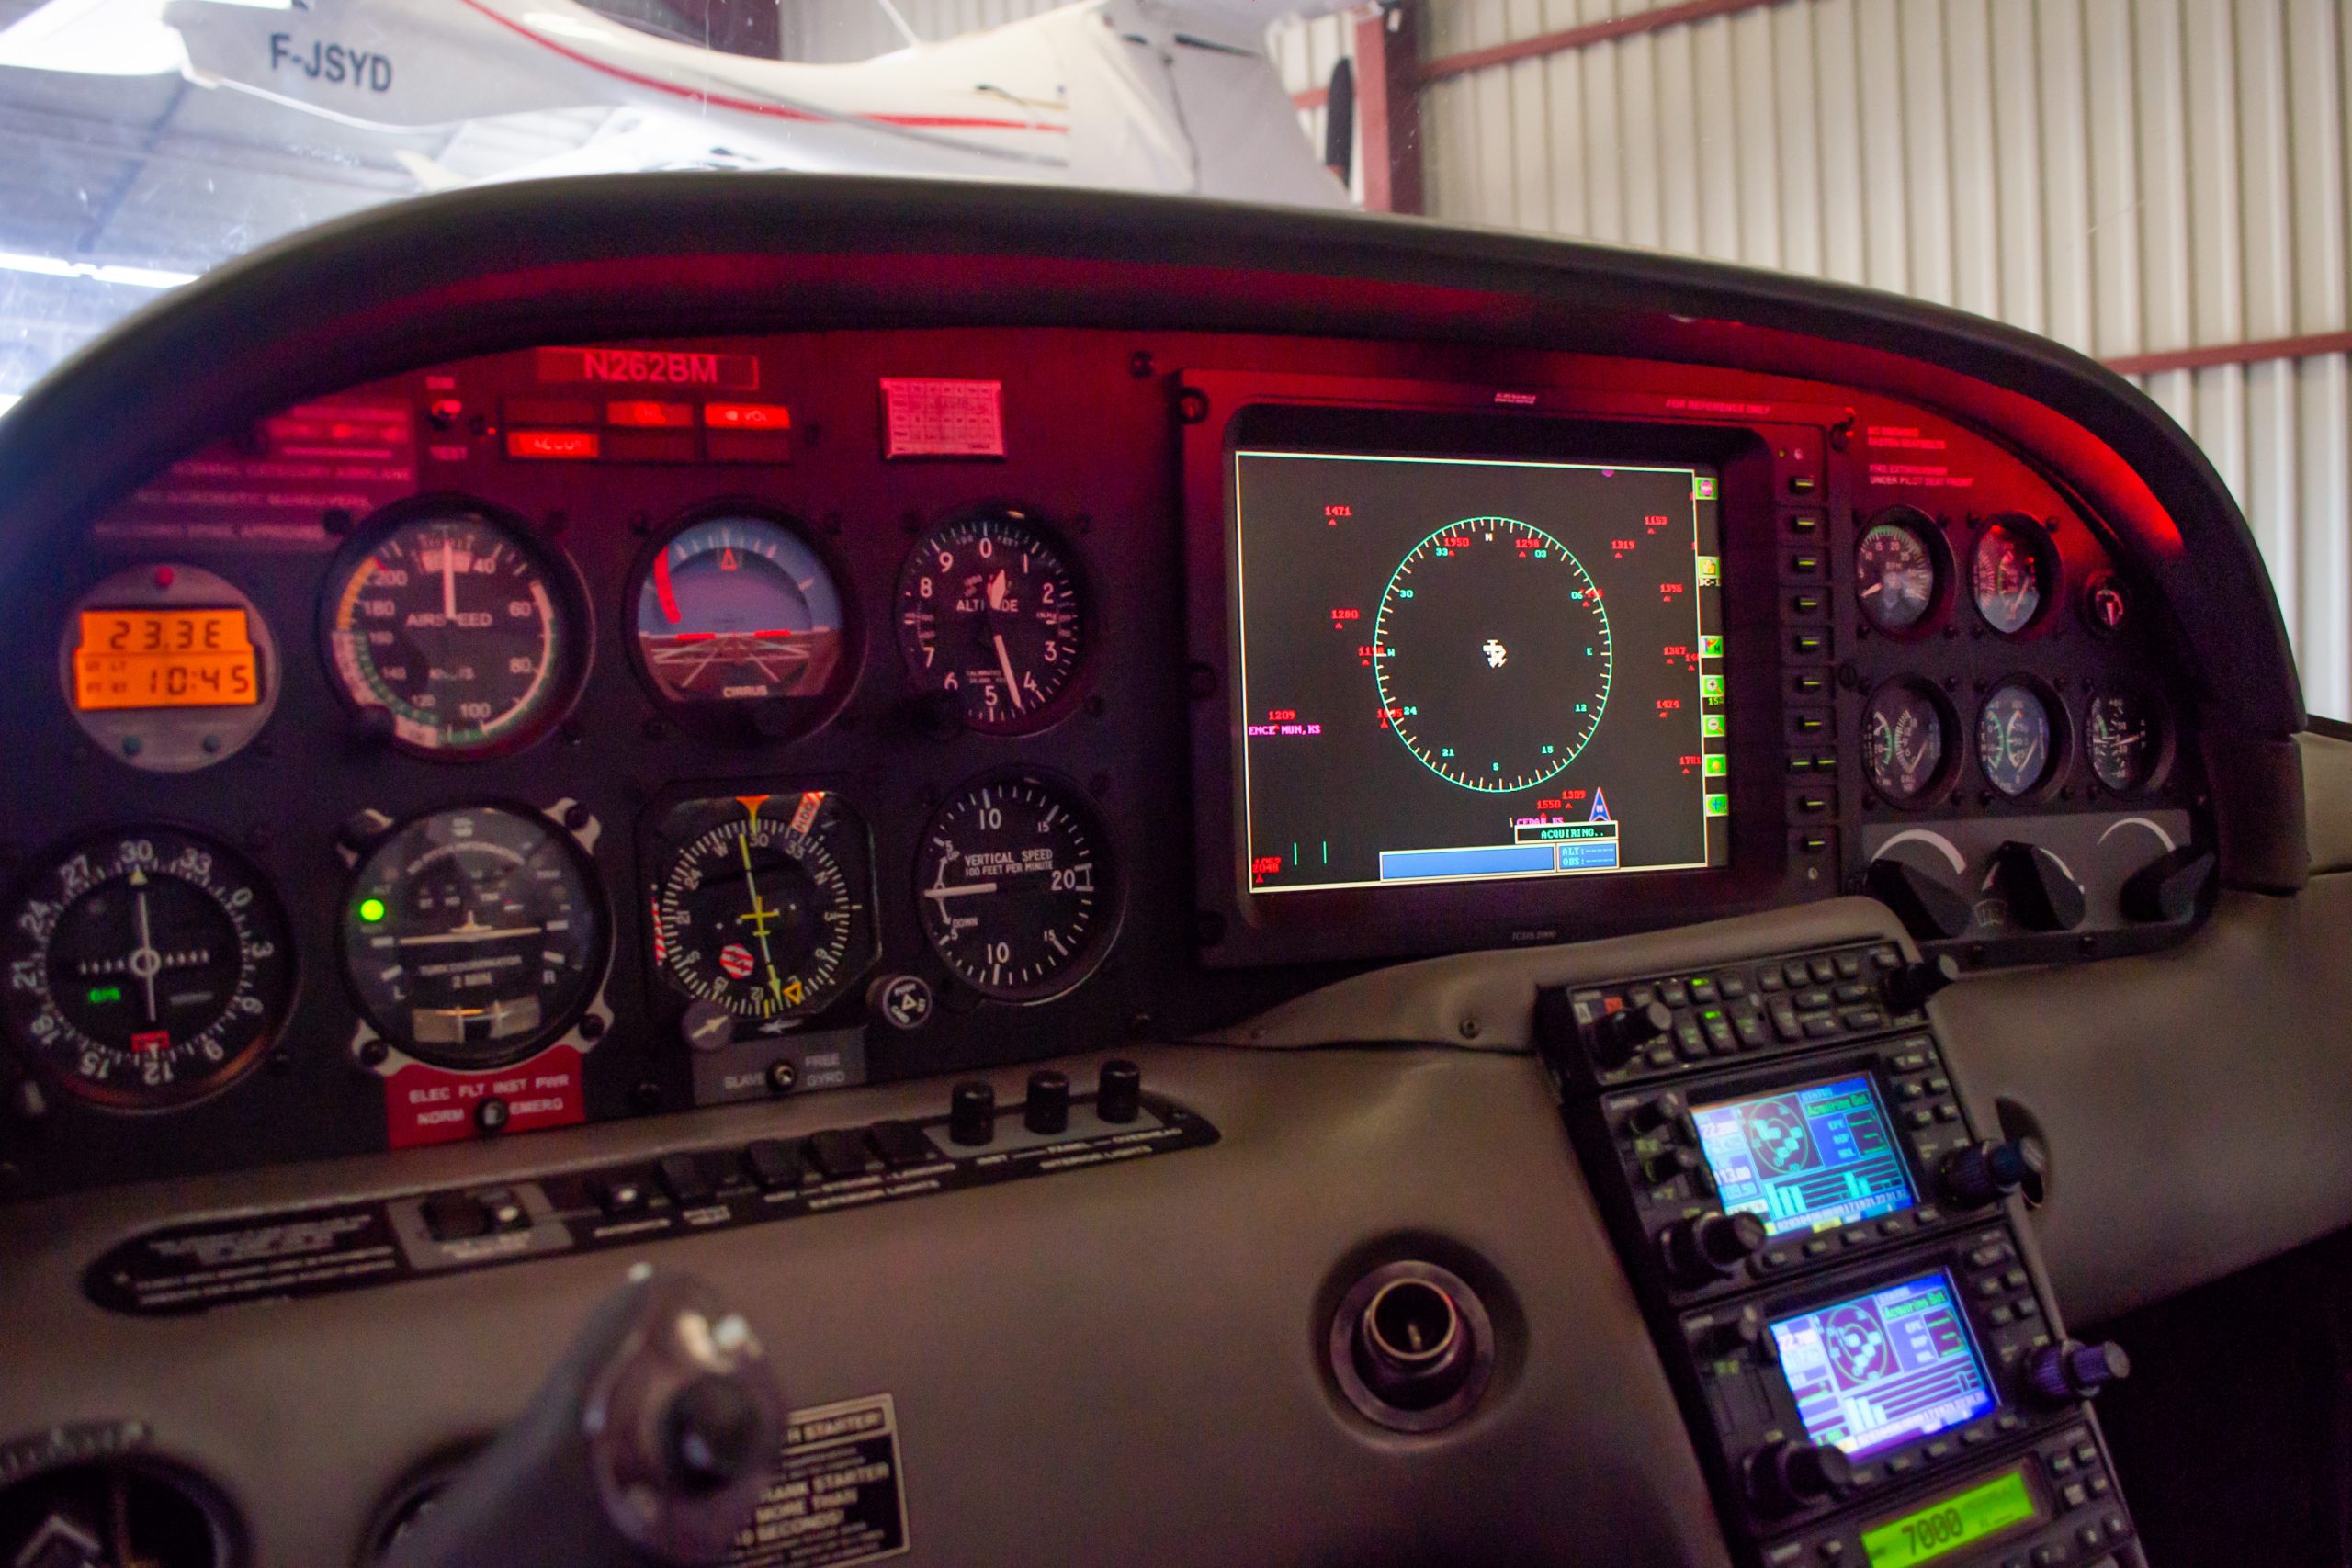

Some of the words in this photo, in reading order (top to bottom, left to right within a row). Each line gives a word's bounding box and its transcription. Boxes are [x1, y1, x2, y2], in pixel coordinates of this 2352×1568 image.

[271, 33, 392, 93] F-JSYD
[1325, 505, 1351, 516] 1471
[1486, 533, 1493, 542] N
[978, 537, 993, 558] 0
[1435, 547, 1448, 558] 33
[472, 557, 496, 575] 40
[939, 551, 954, 574] 9
[1023, 552, 1029, 574] 1
[920, 576, 934, 599] 8
[1042, 581, 1056, 604] 2
[1399, 589, 1414, 599] 30
[956, 598, 1019, 613] ALTIDE
[405, 612, 493, 628] AIRSEED
[922, 645, 936, 669] 7
[1044, 640, 1057, 662] 3
[1586, 647, 1593, 657] E
[509, 656, 533, 674] 80
[151, 663, 250, 696] 10:45
[944, 671, 959, 691] 6
[1023, 671, 1038, 692] 4
[984, 685, 999, 706] 5
[459, 702, 492, 719] 100
[1403, 705, 1418, 716] 24
[1574, 704, 1588, 714] 12
[1442, 748, 1455, 757] 21
[1541, 745, 1554, 754] 15
[1492, 761, 1499, 772] S
[979, 807, 1002, 830] 10
[1037, 820, 1050, 833] 15
[749, 833, 770, 848] 30
[120, 839, 154, 863] 30
[784, 840, 806, 860] 33
[964, 851, 1015, 867] VERTICAL
[1021, 848, 1054, 863] SPEED
[965, 865, 982, 877] 100
[981, 863, 1004, 876] FEET
[1005, 862, 1023, 874] PER
[1024, 860, 1054, 872] MINUTE
[1051, 868, 1077, 892] 20
[952, 917, 978, 930] DOWN
[949, 927, 959, 941] 5
[1043, 929, 1057, 942] 15
[987, 942, 1011, 965] 10
[804, 1052, 840, 1067] FREE
[807, 1070, 845, 1086] GYRO
[1901, 1507, 1965, 1558] 7000
